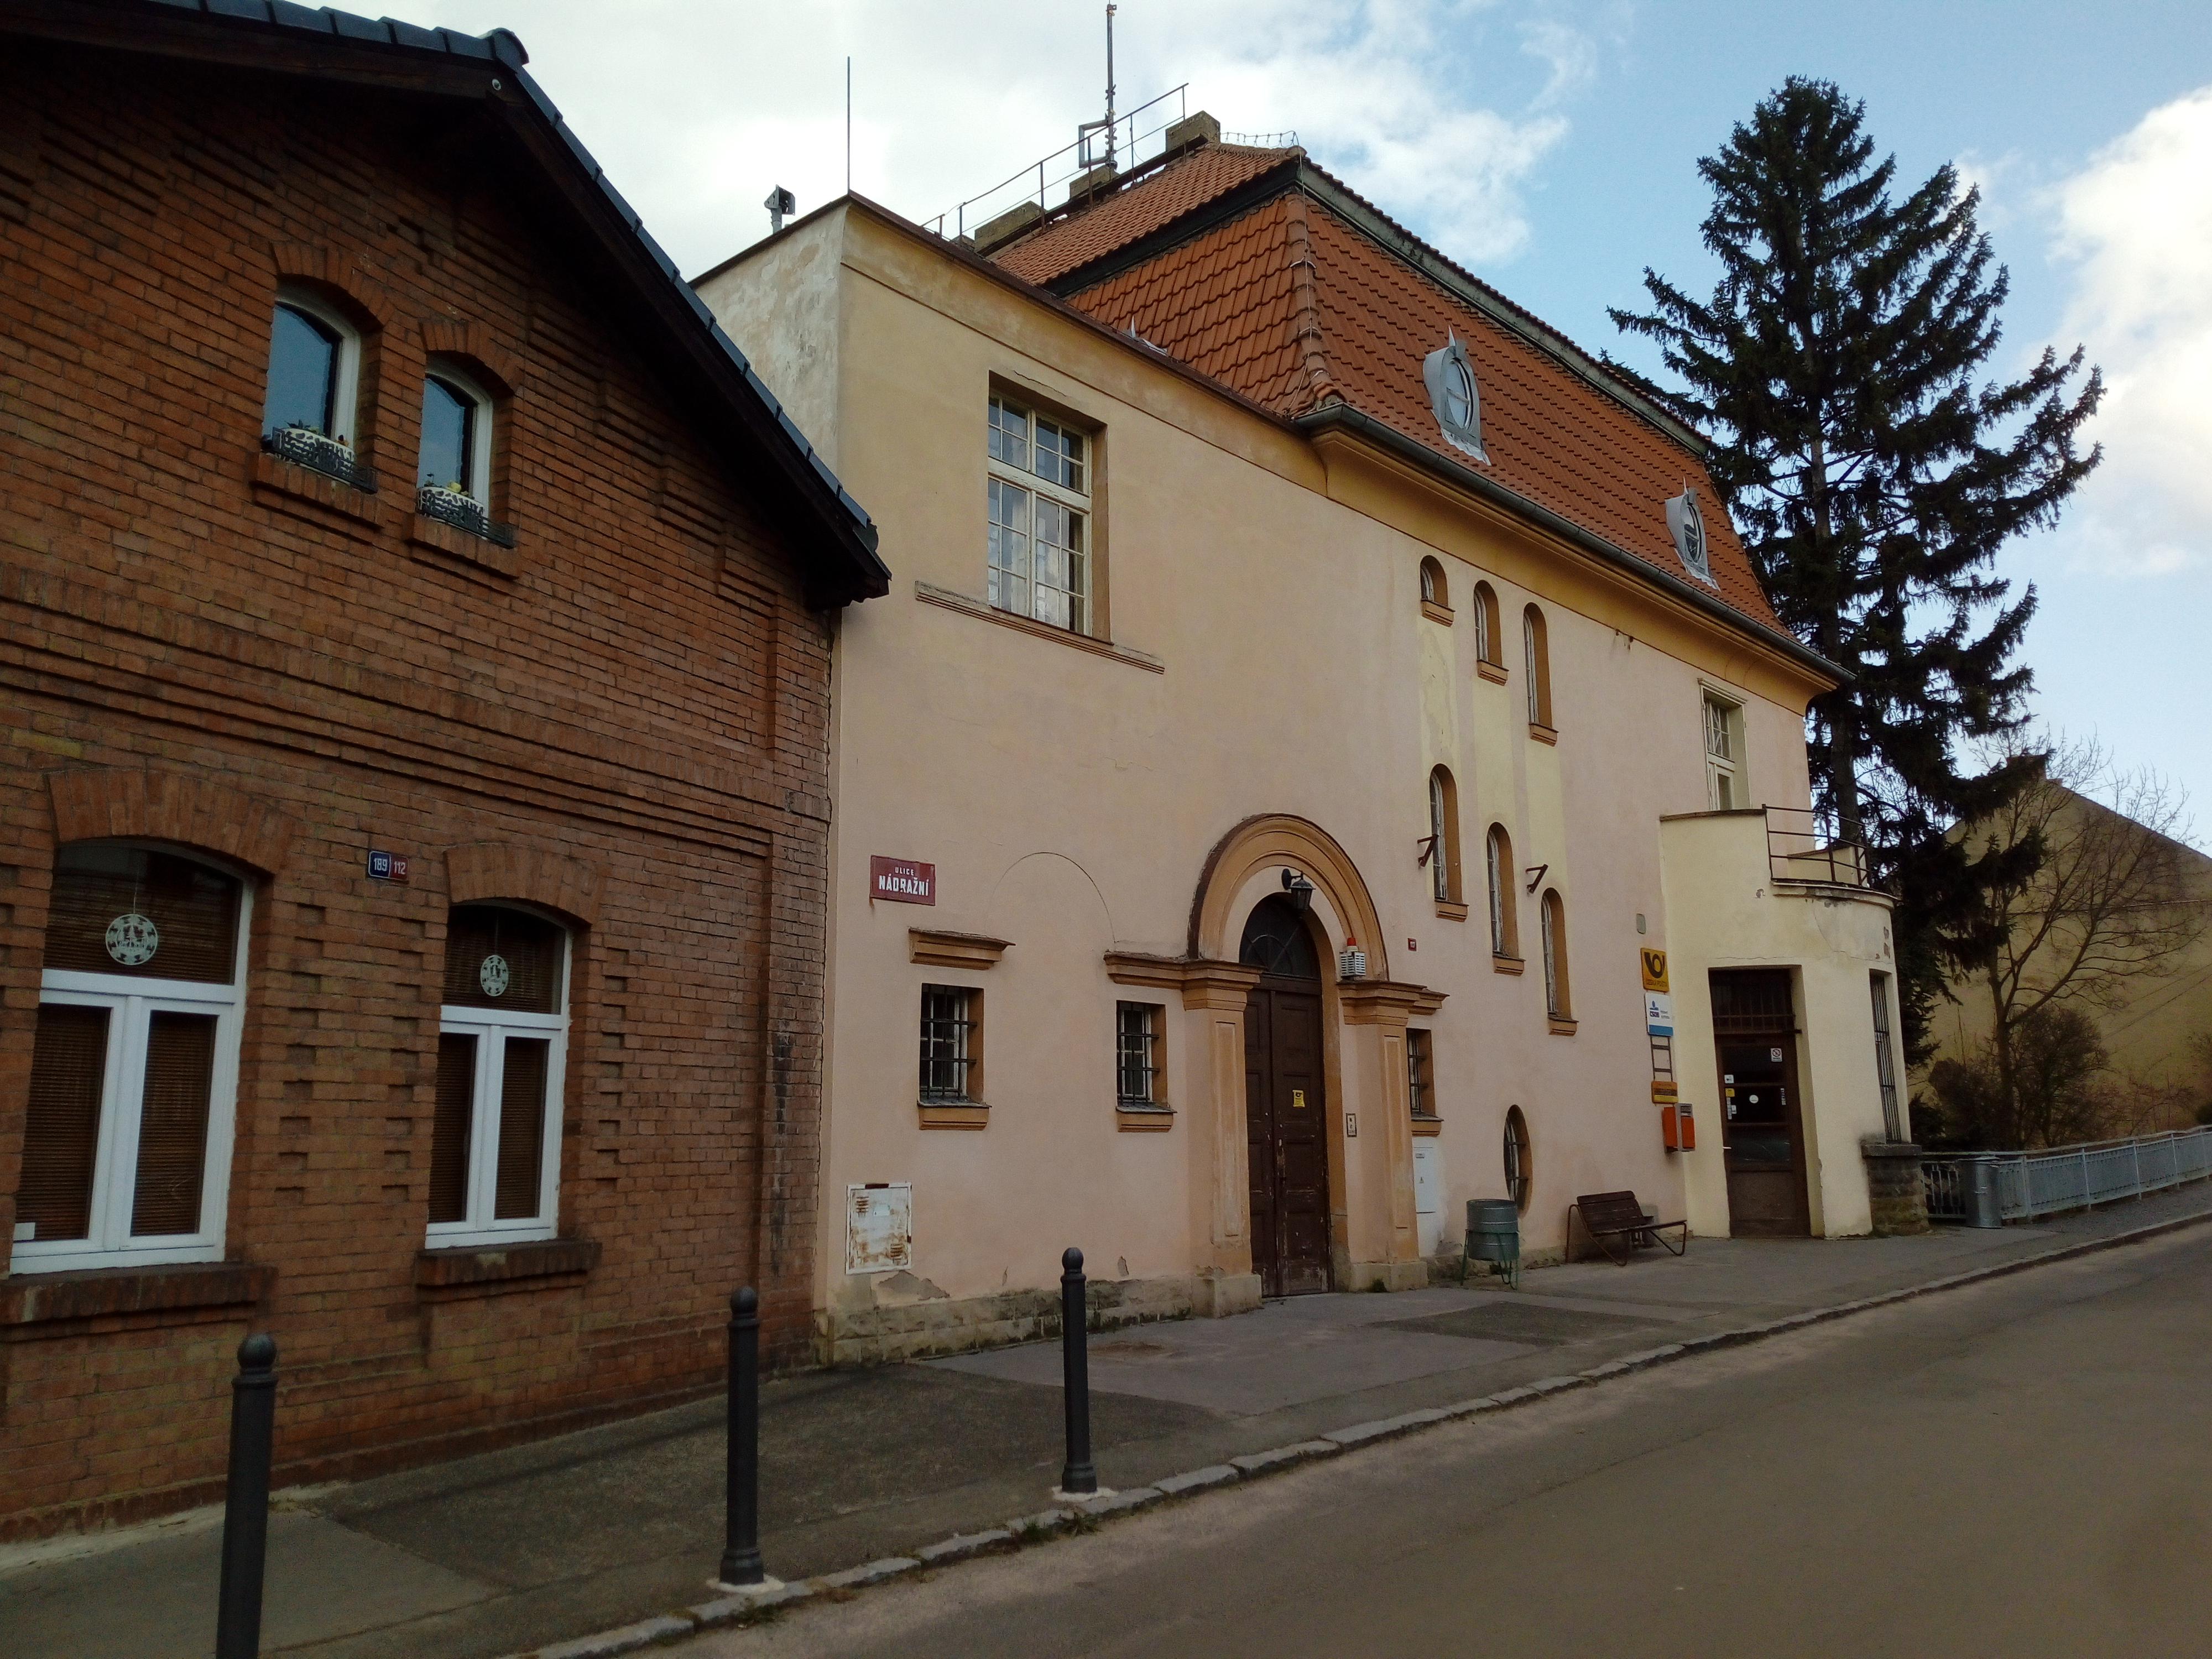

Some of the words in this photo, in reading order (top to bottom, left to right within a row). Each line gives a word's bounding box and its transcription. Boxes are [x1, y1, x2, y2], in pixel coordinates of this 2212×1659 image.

[373, 858, 388, 872] 189
[394, 860, 406, 875] 112
[895, 867, 914, 876] ULICE
[879, 873, 929, 896] NÁDRAŽNÍ
